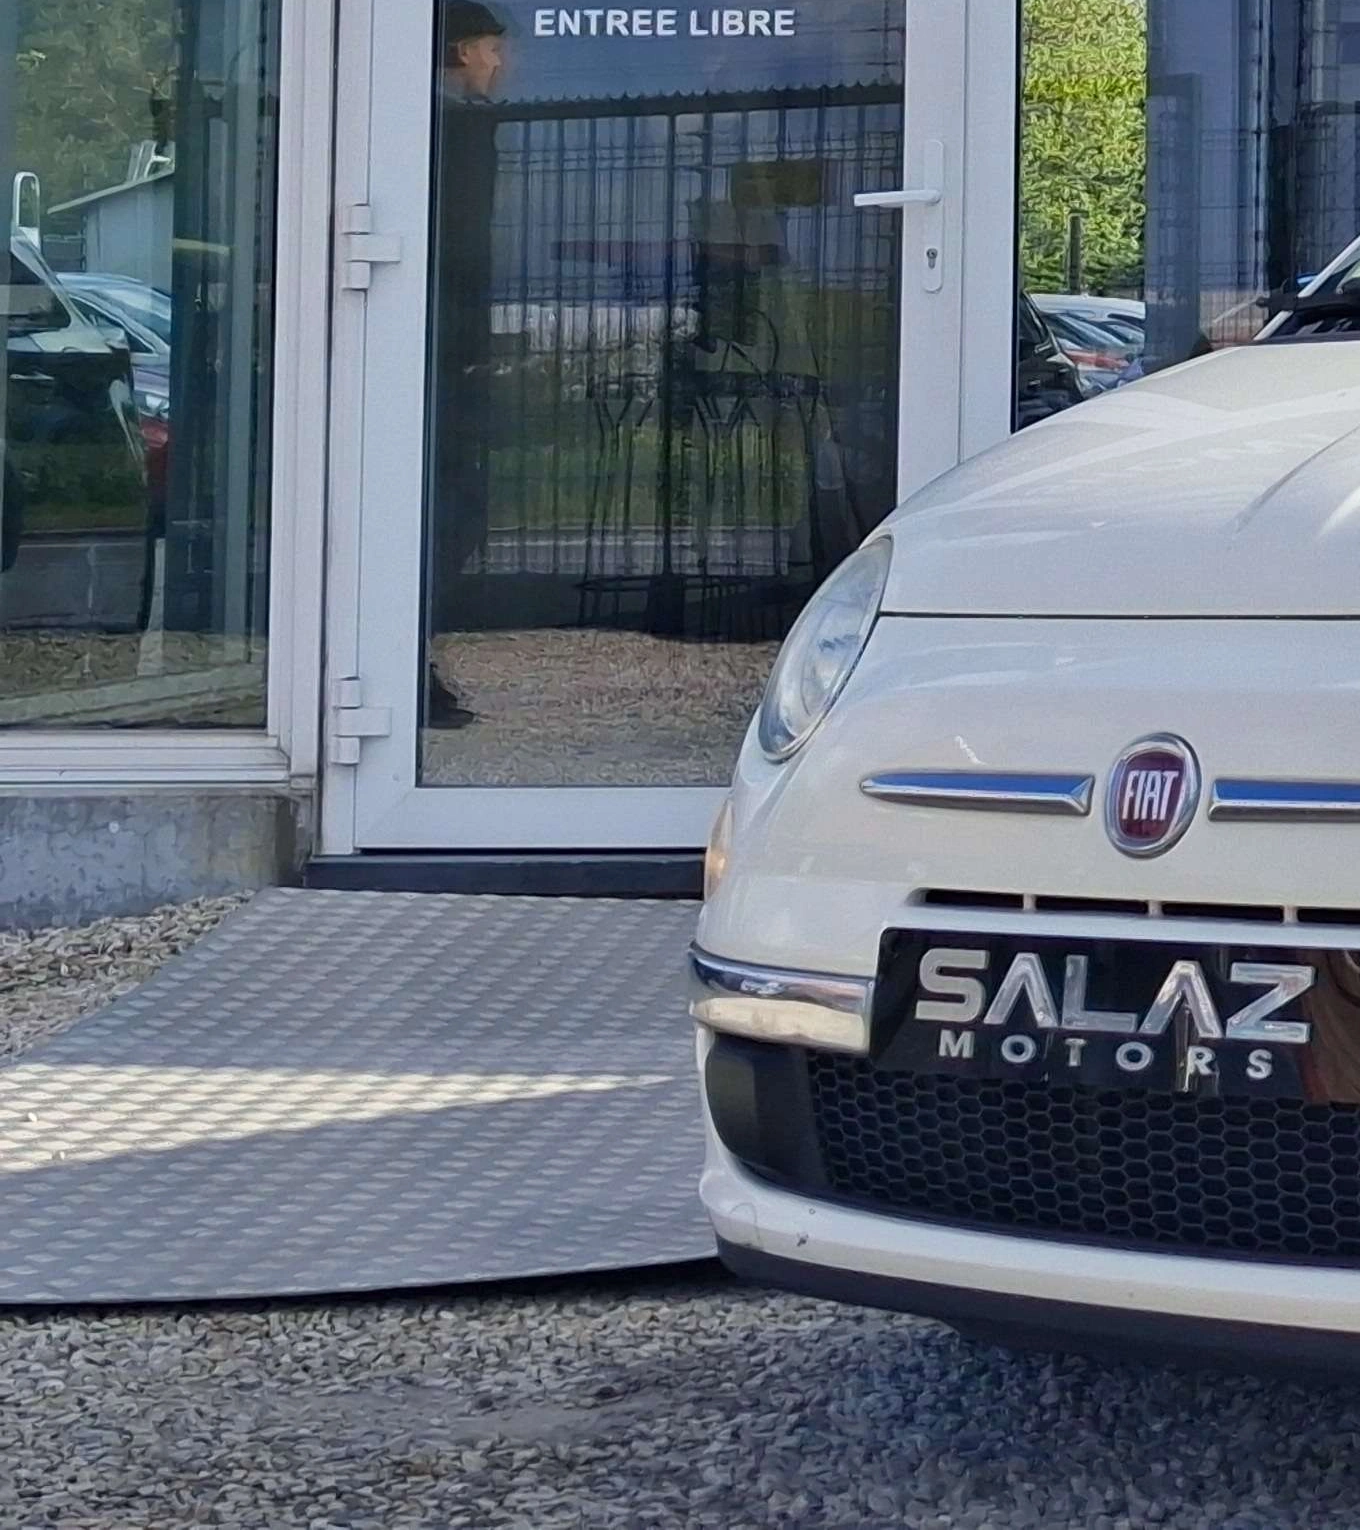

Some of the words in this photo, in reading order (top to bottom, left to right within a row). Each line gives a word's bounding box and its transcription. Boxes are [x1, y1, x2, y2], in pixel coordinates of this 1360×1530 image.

[534, 9, 677, 37] ENTREE
[690, 9, 795, 37] LIBRE
[1121, 769, 1180, 823] FIAT
[914, 947, 1317, 1044] SALAZ
[937, 1029, 1274, 1081] MOTORS
